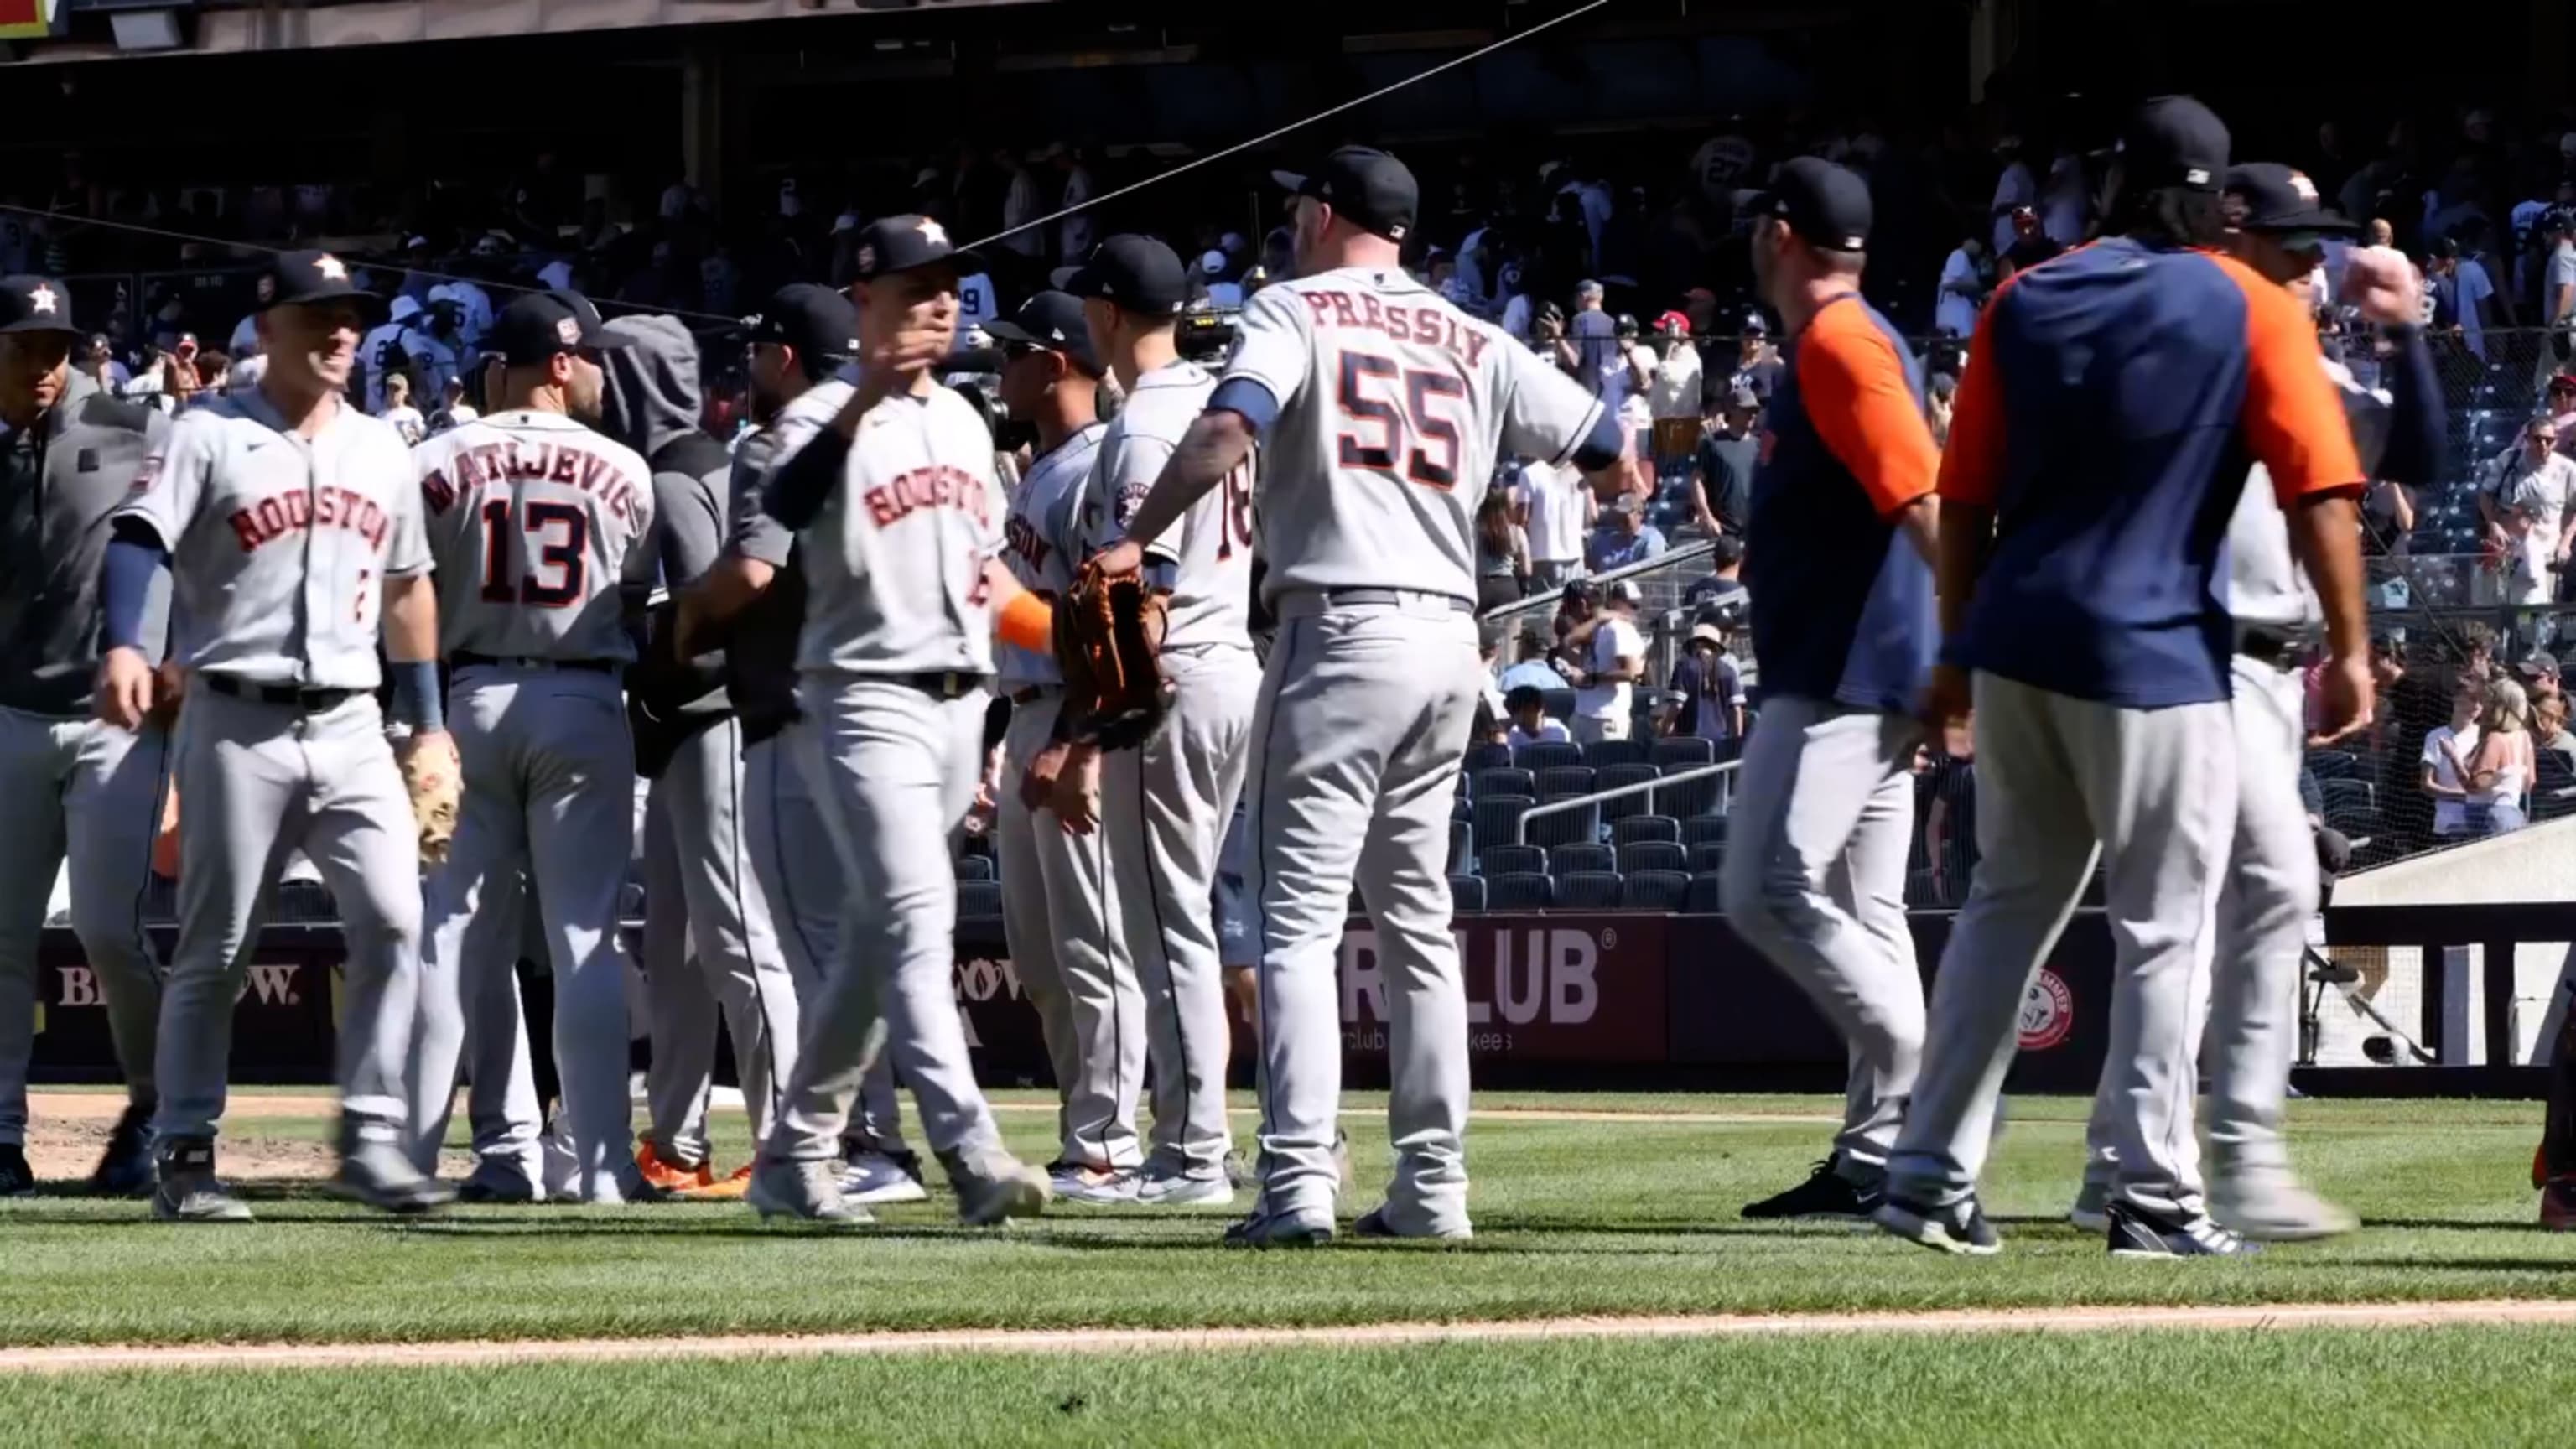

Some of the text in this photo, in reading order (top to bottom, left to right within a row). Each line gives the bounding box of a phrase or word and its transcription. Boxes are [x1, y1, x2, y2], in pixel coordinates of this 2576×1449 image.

[1299, 290, 1490, 368] PRESSLY
[1337, 349, 1465, 491] 55
[479, 498, 589, 610] 13
